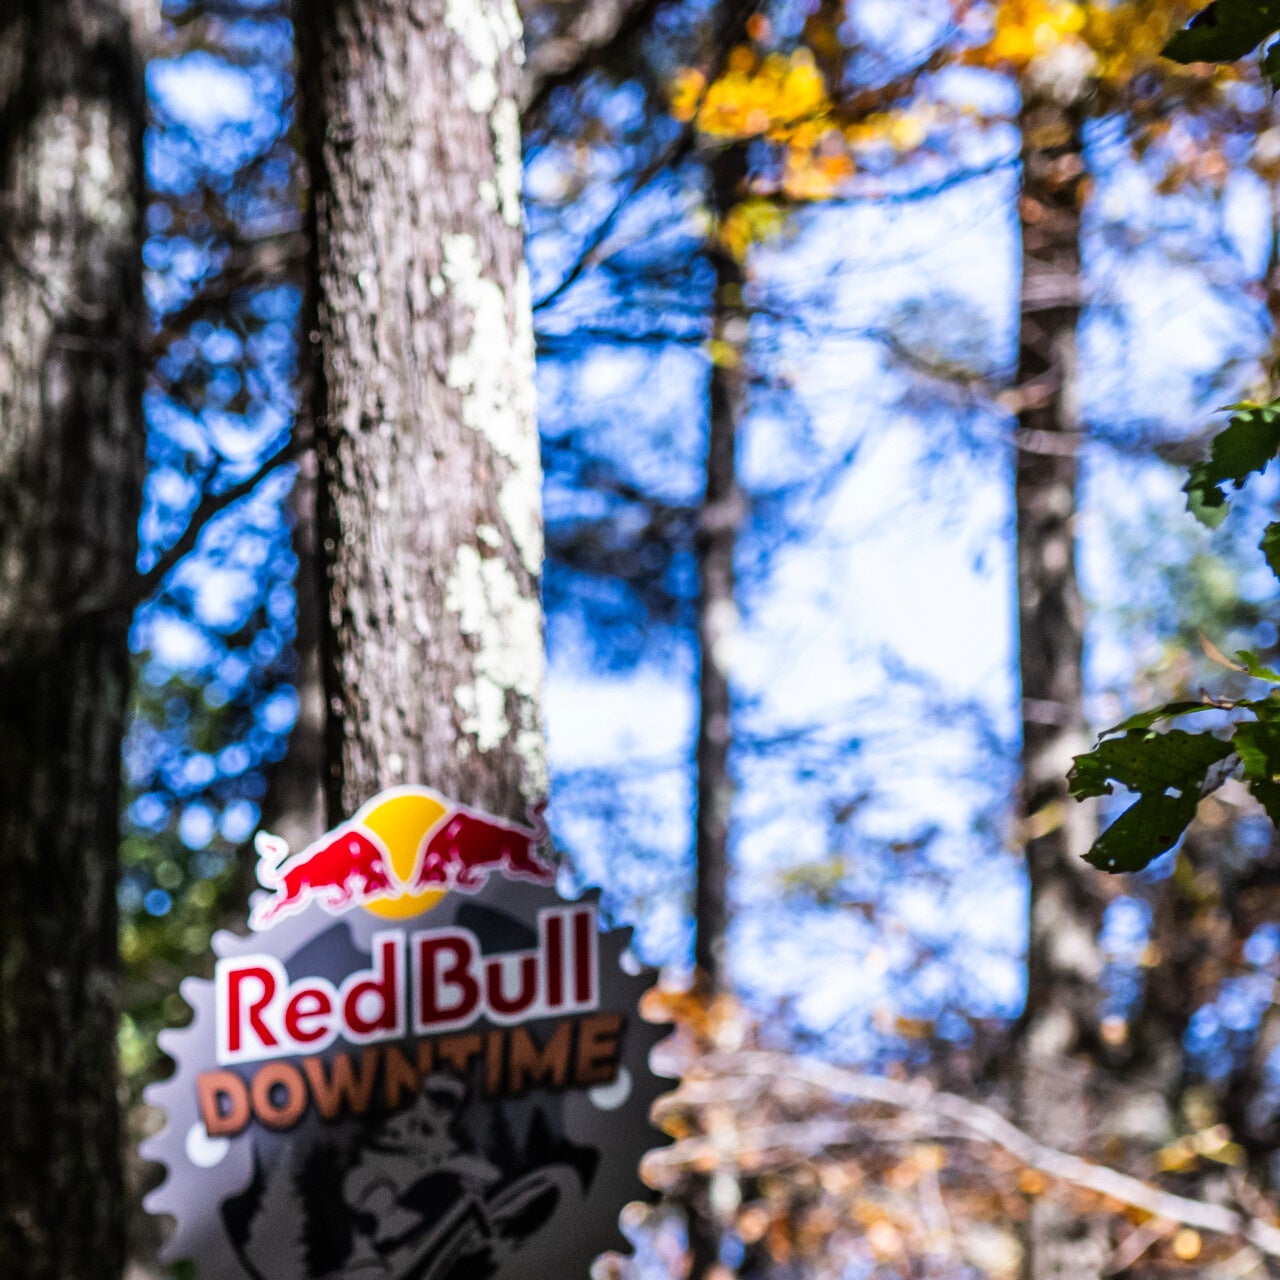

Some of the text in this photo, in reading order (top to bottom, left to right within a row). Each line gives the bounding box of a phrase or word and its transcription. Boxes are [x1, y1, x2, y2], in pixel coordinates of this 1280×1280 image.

[223, 907, 595, 1057] Red Bull
[195, 1012, 626, 1139] DOWNTIME
